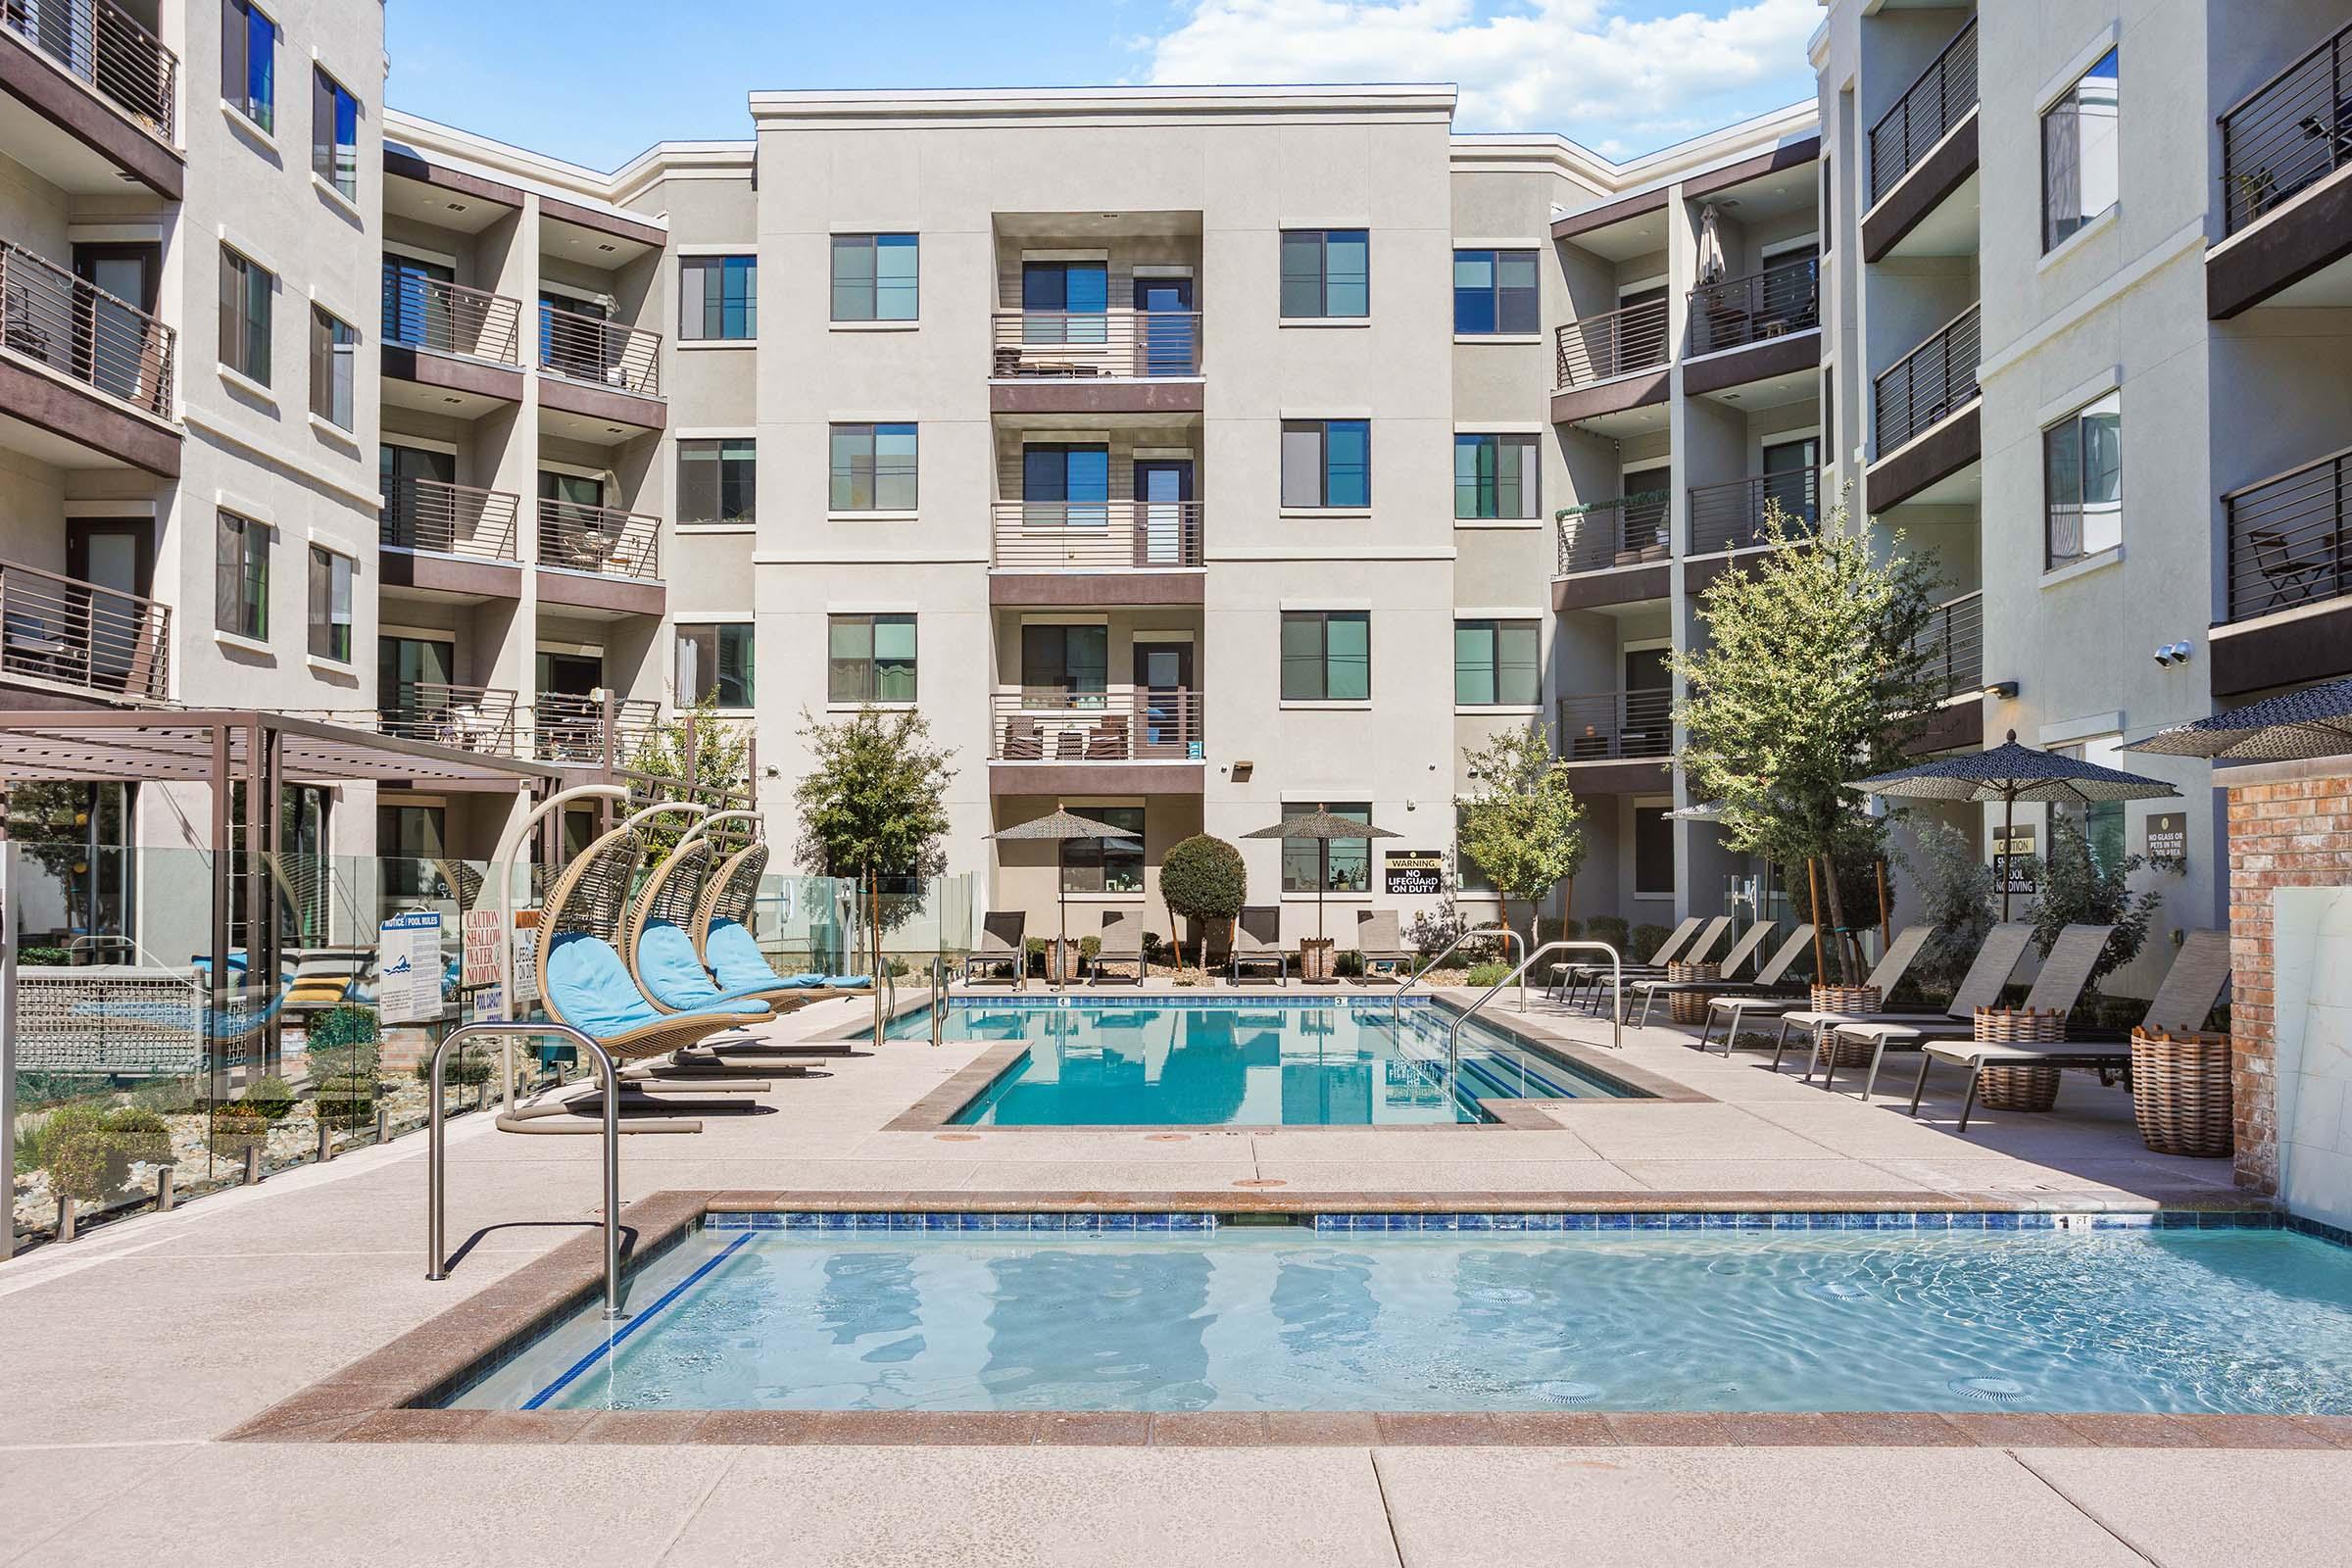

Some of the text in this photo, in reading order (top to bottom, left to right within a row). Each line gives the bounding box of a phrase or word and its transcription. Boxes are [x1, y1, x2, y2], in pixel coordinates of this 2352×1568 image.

[1998, 840, 2029, 852] CTION
[2009, 869, 2024, 880] OOL
[2008, 880, 2033, 893] DIVING
[384, 917, 405, 927] NOTICE
[408, 916, 421, 926] POOL
[421, 916, 438, 925] RULES
[466, 910, 498, 929] CAUTION
[466, 929, 501, 947] SHALLOW
[466, 948, 493, 966] WATER
[466, 966, 478, 984] NO
[2077, 1215, 2088, 1224] FT
